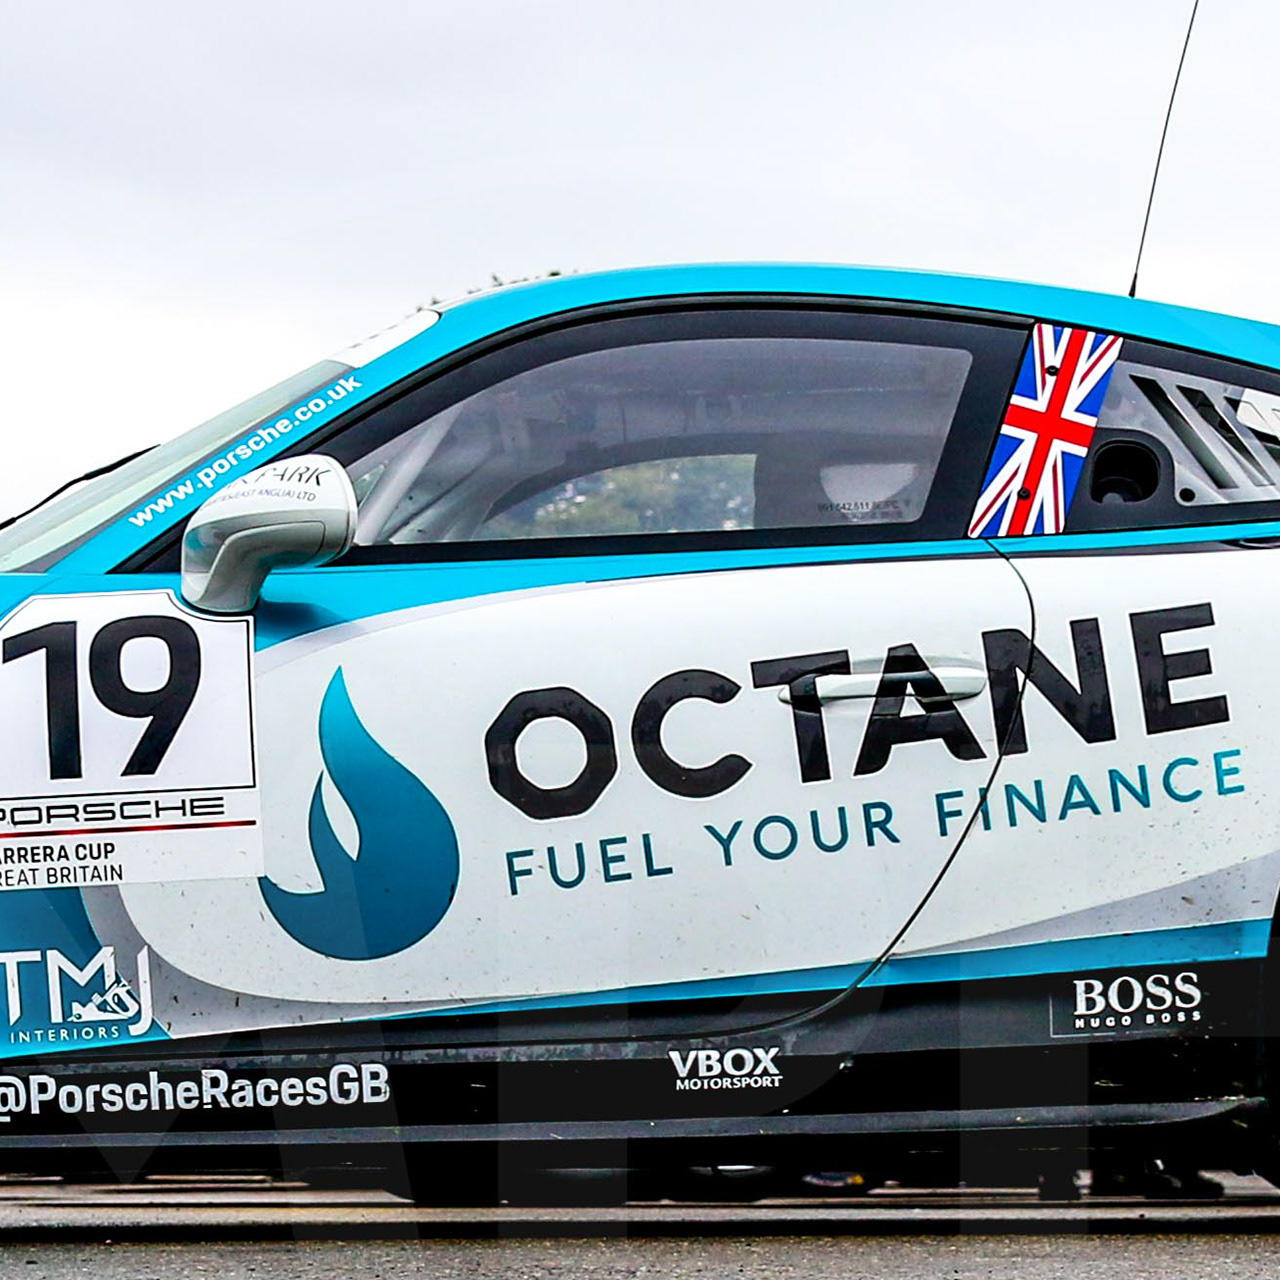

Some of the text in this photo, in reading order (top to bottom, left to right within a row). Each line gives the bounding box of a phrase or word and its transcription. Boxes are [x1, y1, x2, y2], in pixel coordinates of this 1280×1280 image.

[129, 374, 362, 528] www.porsche.co.uk
[297, 490, 317, 502] LTD
[0, 614, 203, 781] 19
[483, 601, 1233, 823] OCTANE
[504, 748, 1247, 897] FUEL YOUR FINANCE
[75, 842, 116, 863] CUP
[36, 863, 124, 885] BRITAIN
[1072, 972, 1202, 1017] BOSS
[1074, 1010, 1202, 1028] HUGO BOSS
[9, 1024, 120, 1043] INTERIORS
[668, 1048, 780, 1077] VBOX
[675, 1074, 783, 1091] MOTORSPORT
